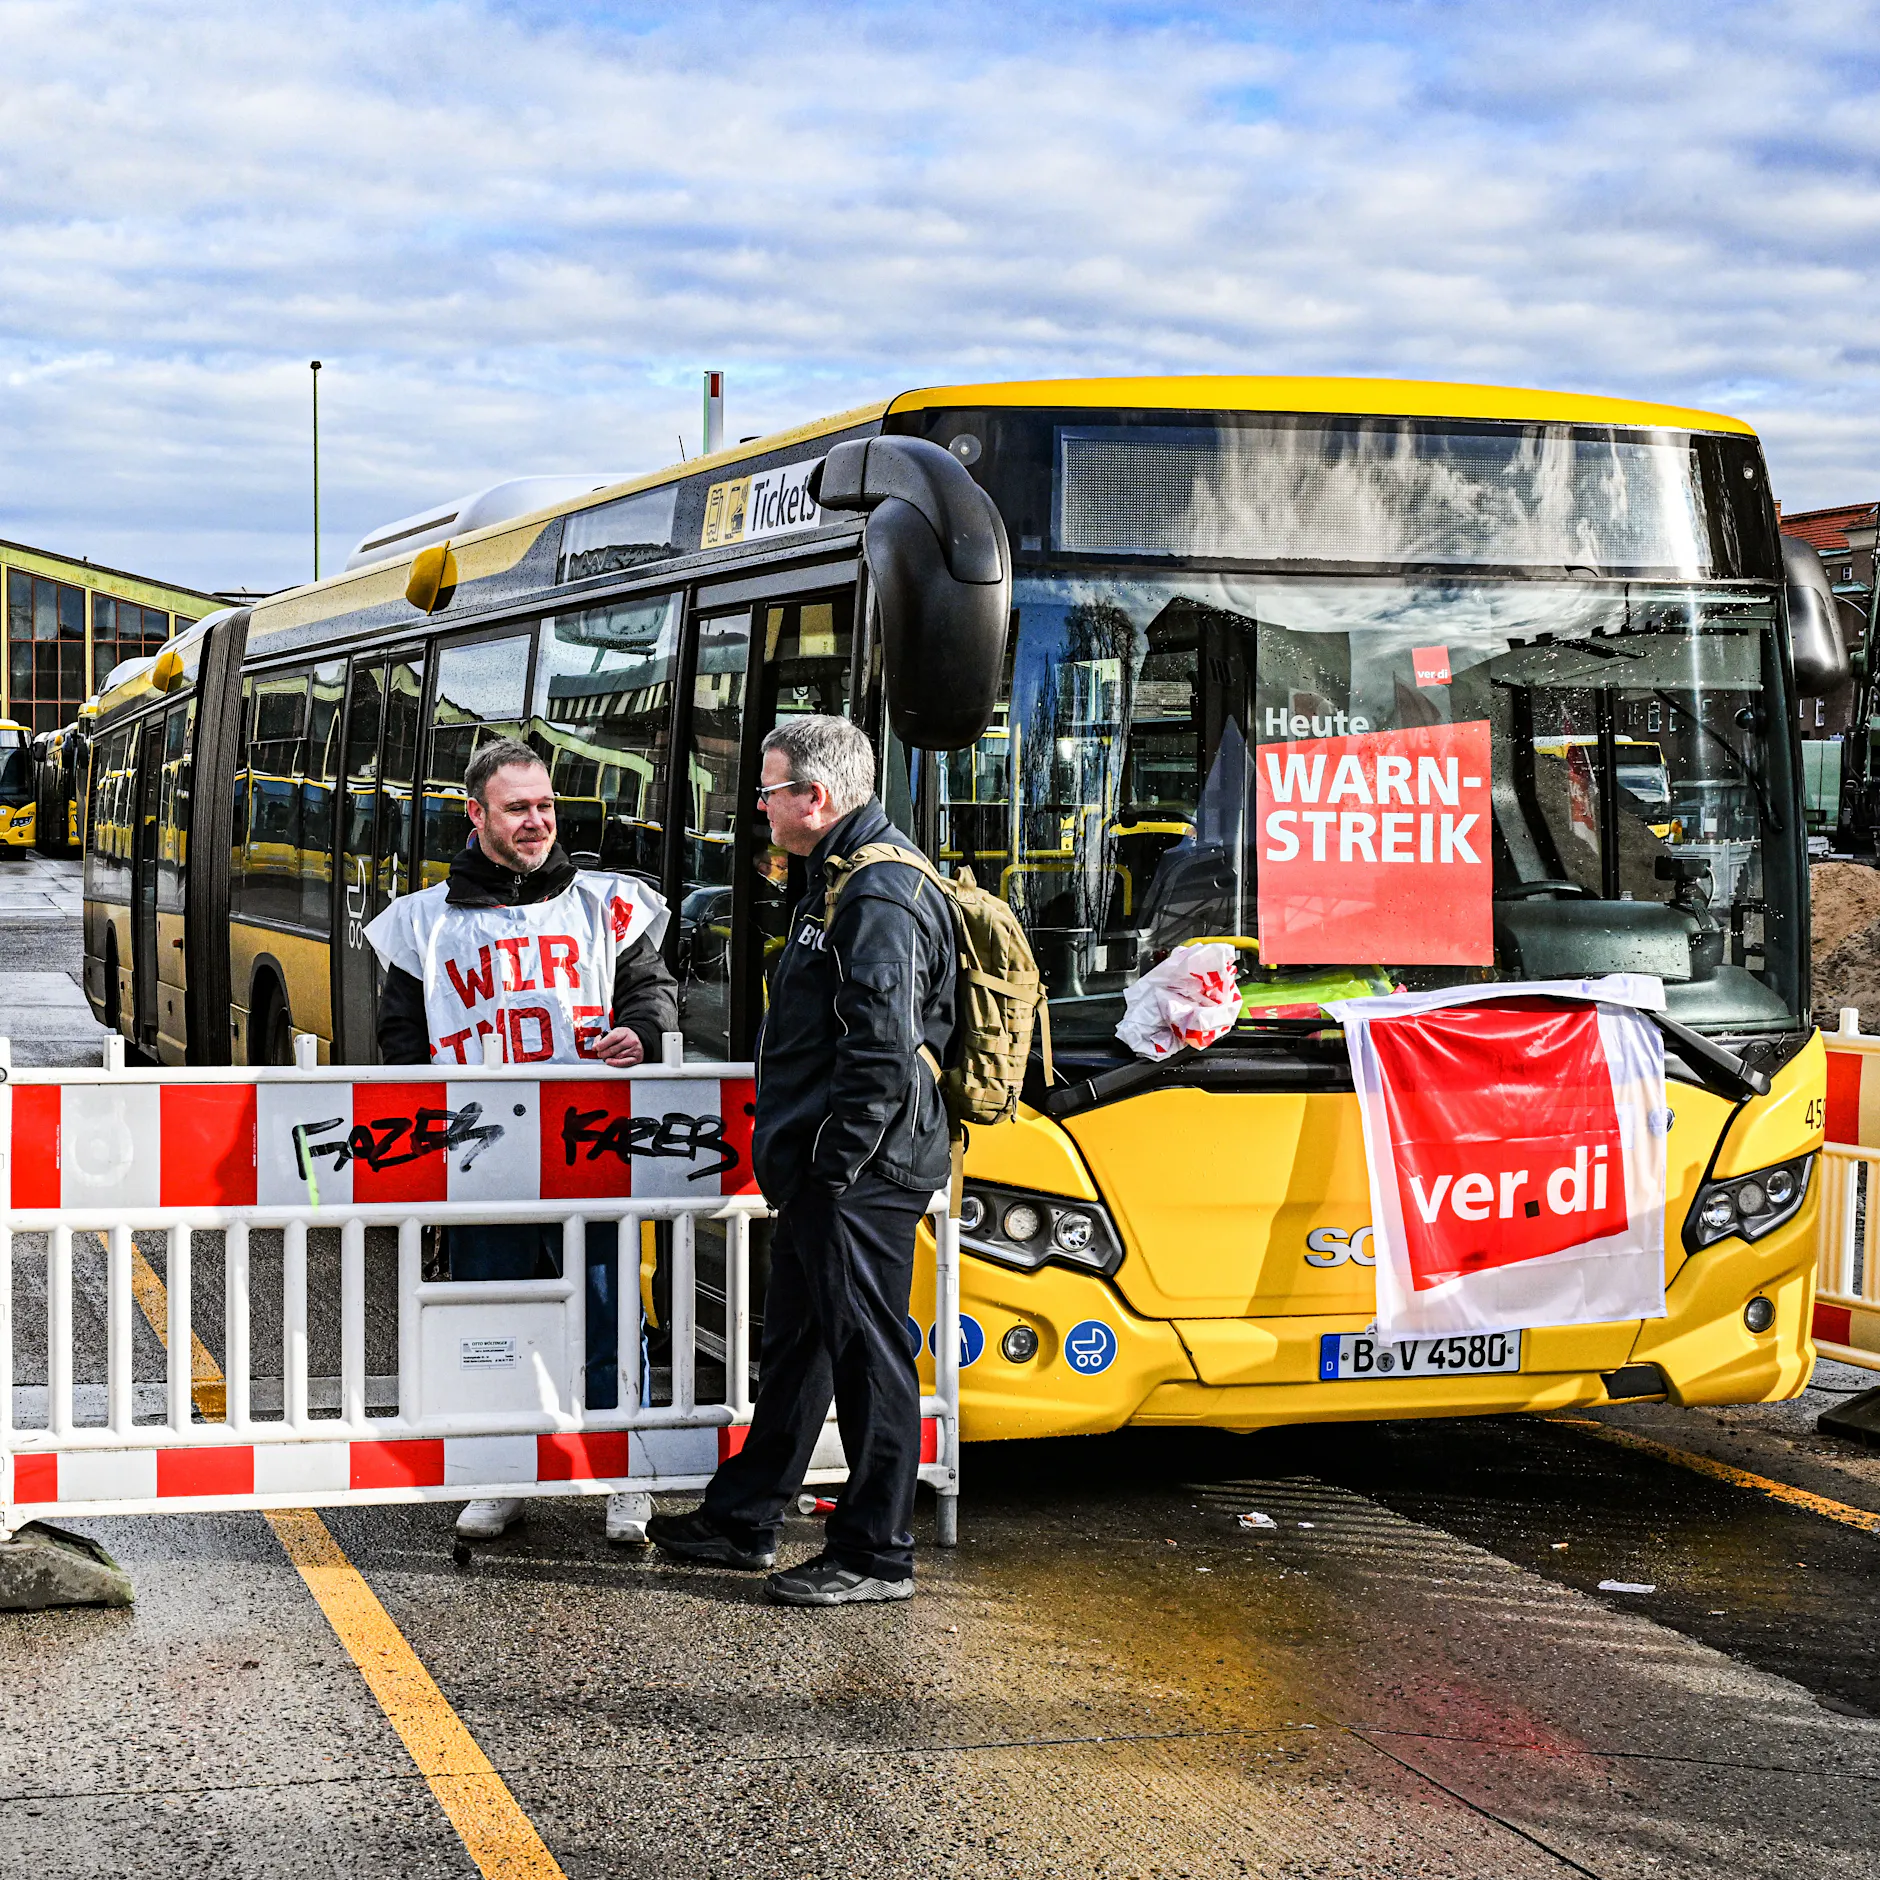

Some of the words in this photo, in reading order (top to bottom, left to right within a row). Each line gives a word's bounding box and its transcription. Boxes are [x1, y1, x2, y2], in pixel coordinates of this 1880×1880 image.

[752, 473, 817, 531] Tickets
[1417, 668, 1448, 680] ver.di
[1265, 707, 1370, 738] Heute
[1265, 753, 1482, 806] WARN-
[1265, 810, 1482, 864] STREIK
[444, 934, 581, 1010] WIR
[1409, 1144, 1608, 1224] ver.di
[1427, 1333, 1507, 1370] 4580
